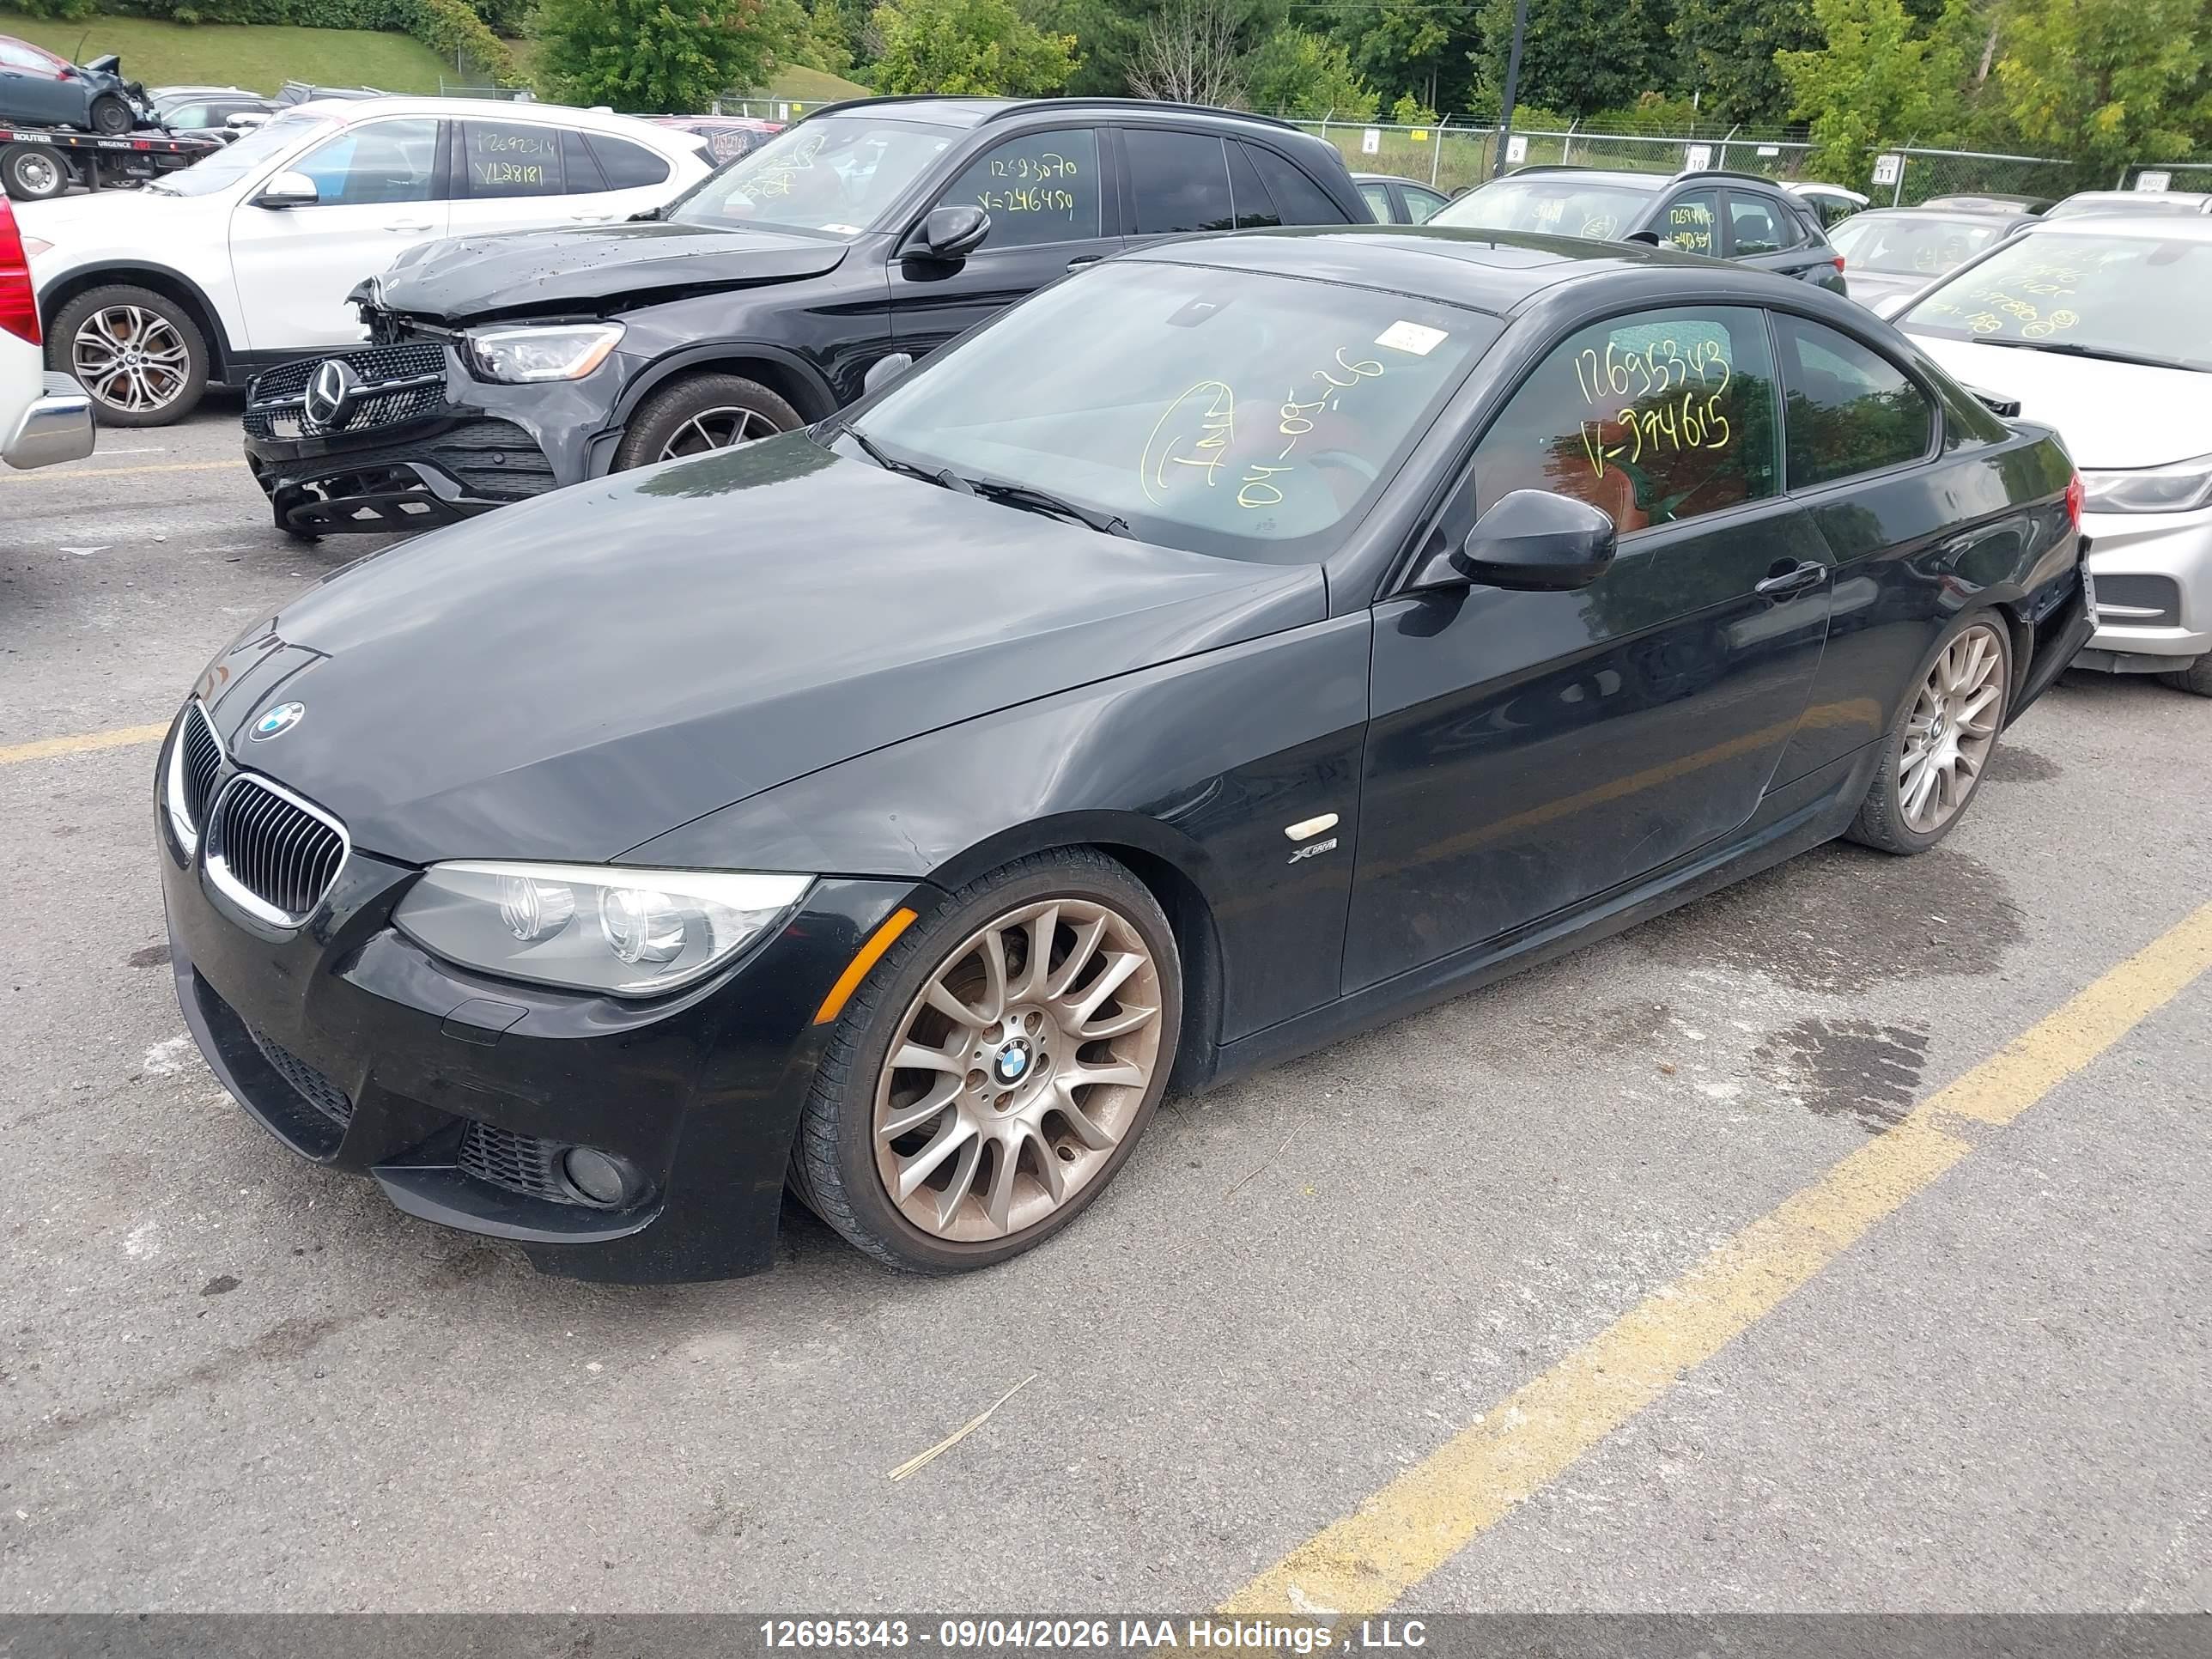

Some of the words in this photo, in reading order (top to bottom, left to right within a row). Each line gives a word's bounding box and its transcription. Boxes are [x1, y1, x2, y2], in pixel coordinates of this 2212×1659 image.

[13, 133, 52, 143] ROUTIER
[97, 140, 131, 149] URGENCE
[1513, 149, 1519, 159] 9
[1692, 160, 1705, 170] 10
[1879, 168, 1892, 179] 11
[1575, 340, 1730, 404] 12695343
[996, 1041, 1030, 1061] BMW
